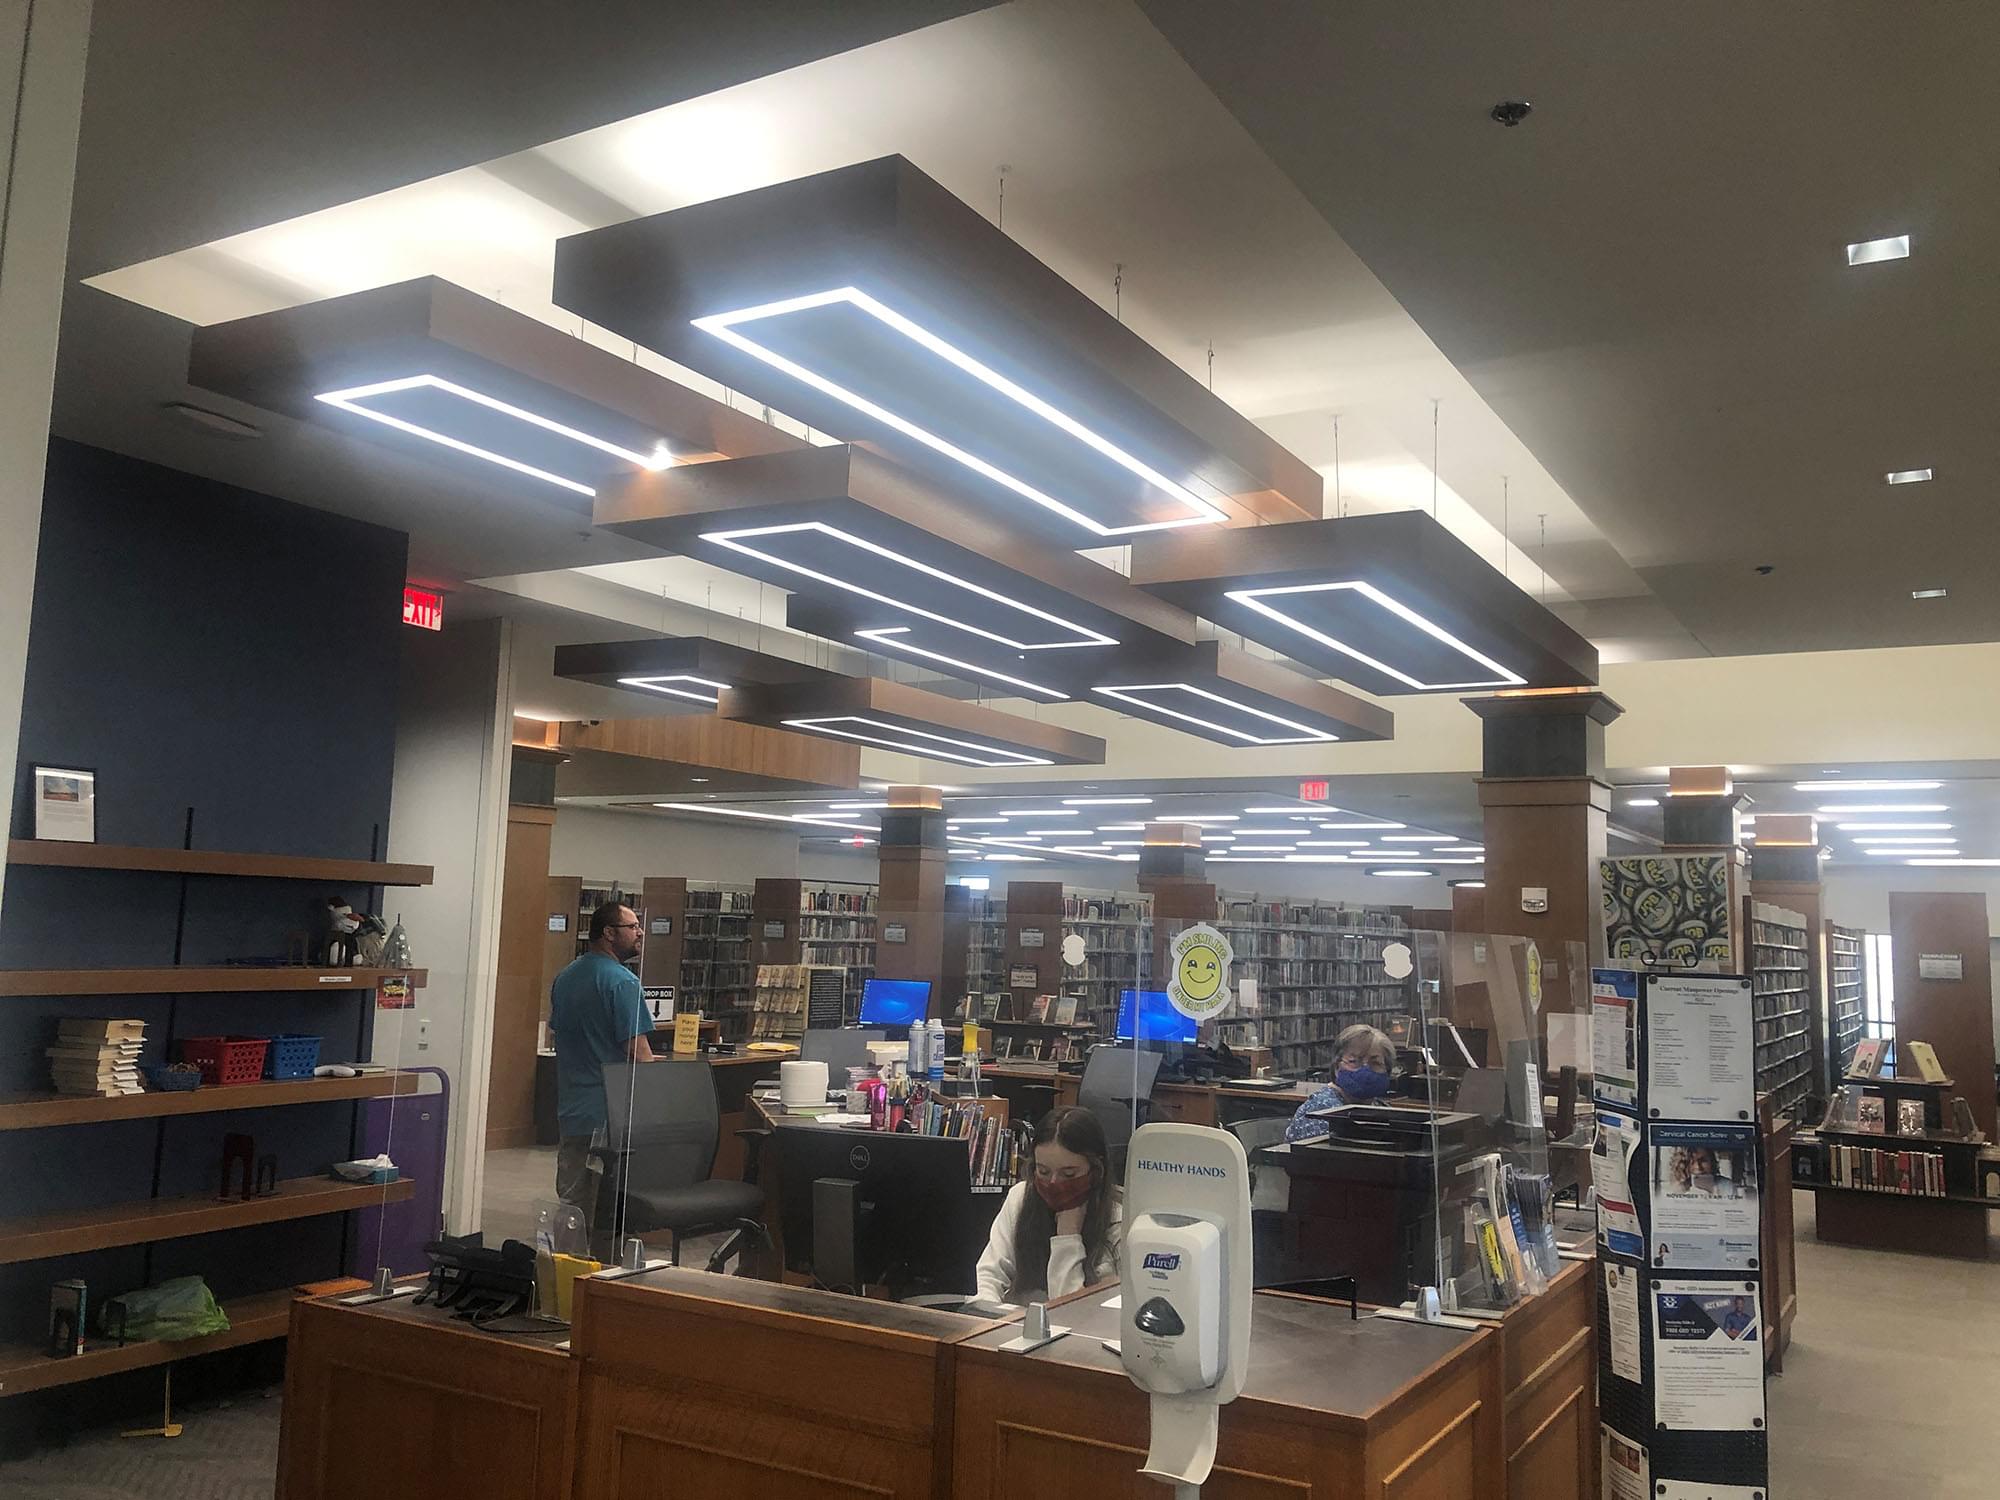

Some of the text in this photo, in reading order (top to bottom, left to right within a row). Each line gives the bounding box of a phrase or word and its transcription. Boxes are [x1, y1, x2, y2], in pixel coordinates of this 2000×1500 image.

[1176, 933, 1228, 960] I'M SMILING
[660, 990, 672, 998] BOX
[1138, 1159, 1226, 1178] HEALTHY HANDS
